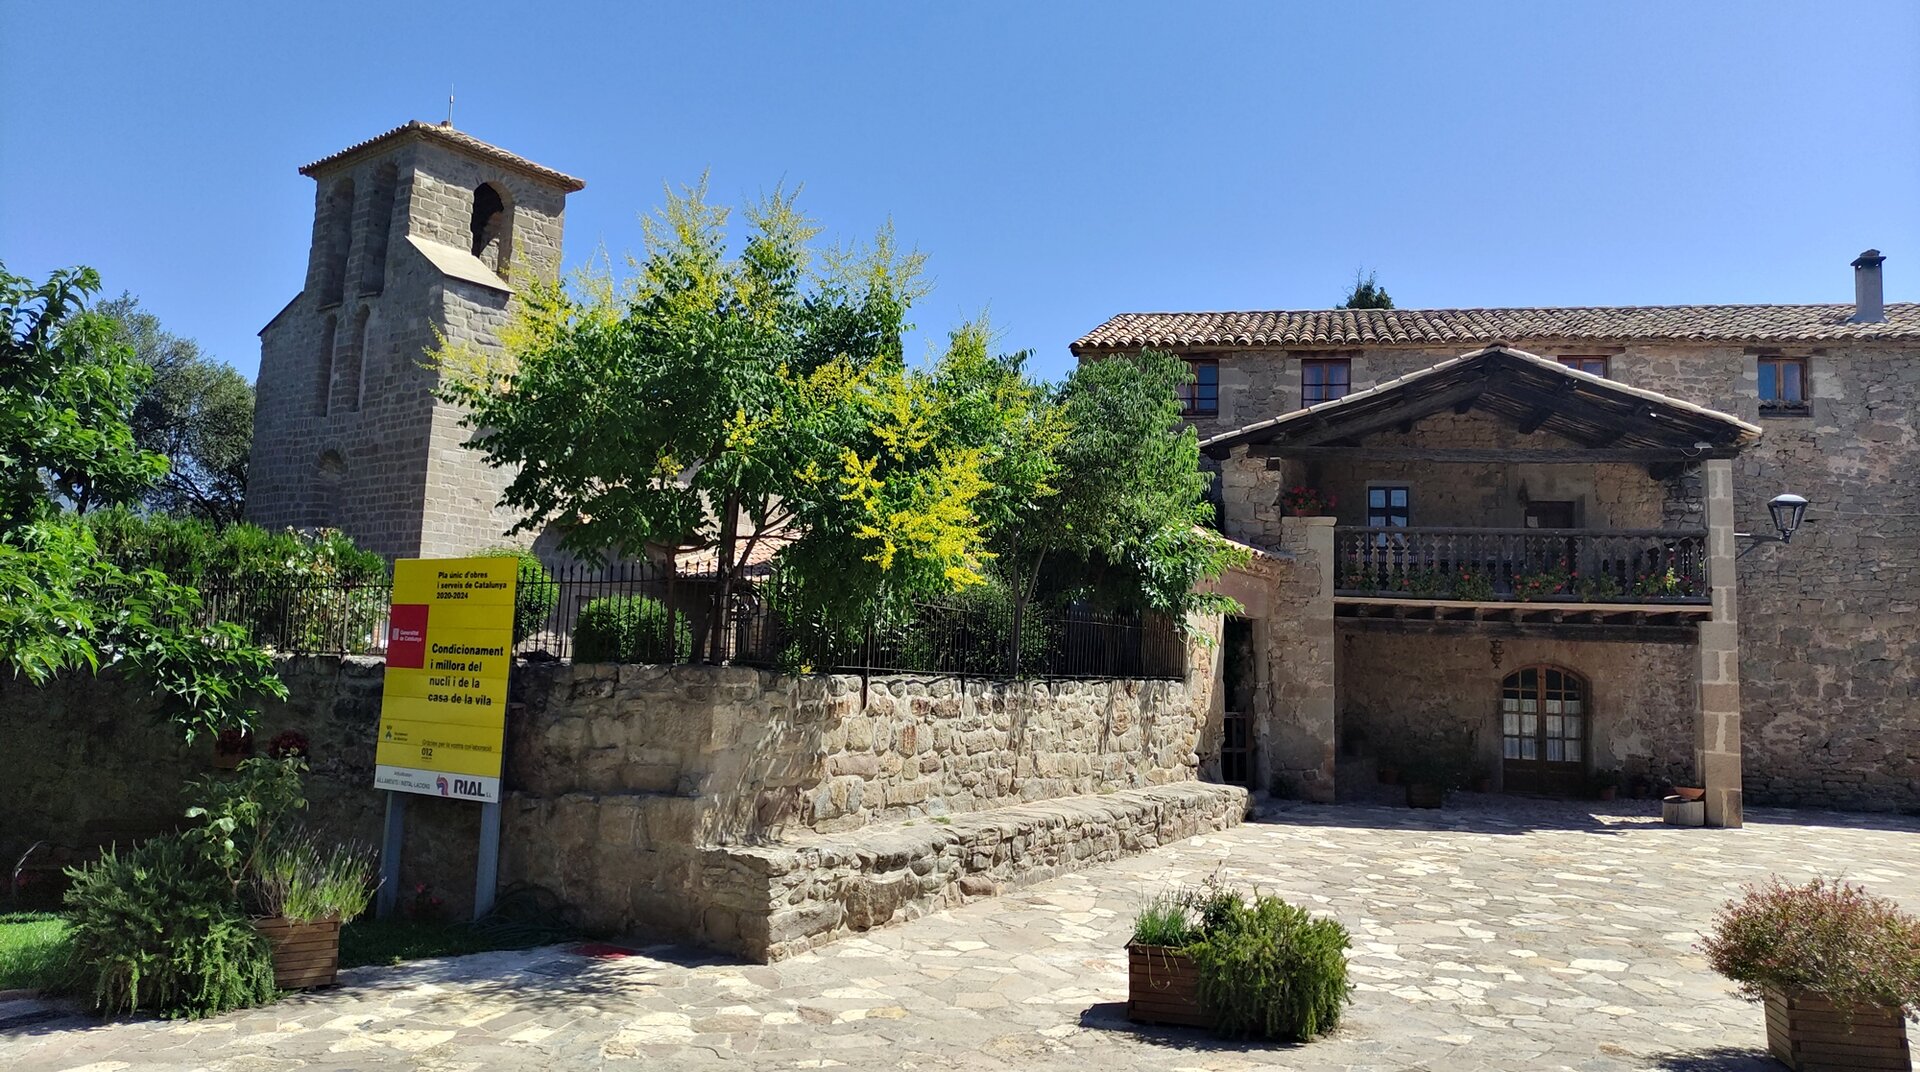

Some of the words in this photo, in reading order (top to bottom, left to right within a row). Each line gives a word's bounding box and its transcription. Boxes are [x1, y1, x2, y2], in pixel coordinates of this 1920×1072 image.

[438, 571, 448, 579] Pla
[449, 571, 463, 579] únic
[464, 571, 488, 579] d'obres
[474, 581, 507, 590] Catalunya
[432, 643, 504, 656] Condicionament
[435, 660, 466, 671] millora
[468, 661, 482, 672] del
[429, 676, 451, 687] nucli
[458, 677, 469, 688] de
[472, 677, 480, 688] la
[428, 693, 449, 703] casa
[451, 693, 462, 704] de
[464, 694, 473, 704] la
[475, 695, 492, 706] vila
[421, 747, 433, 757] 012
[454, 779, 485, 797] RIAL
